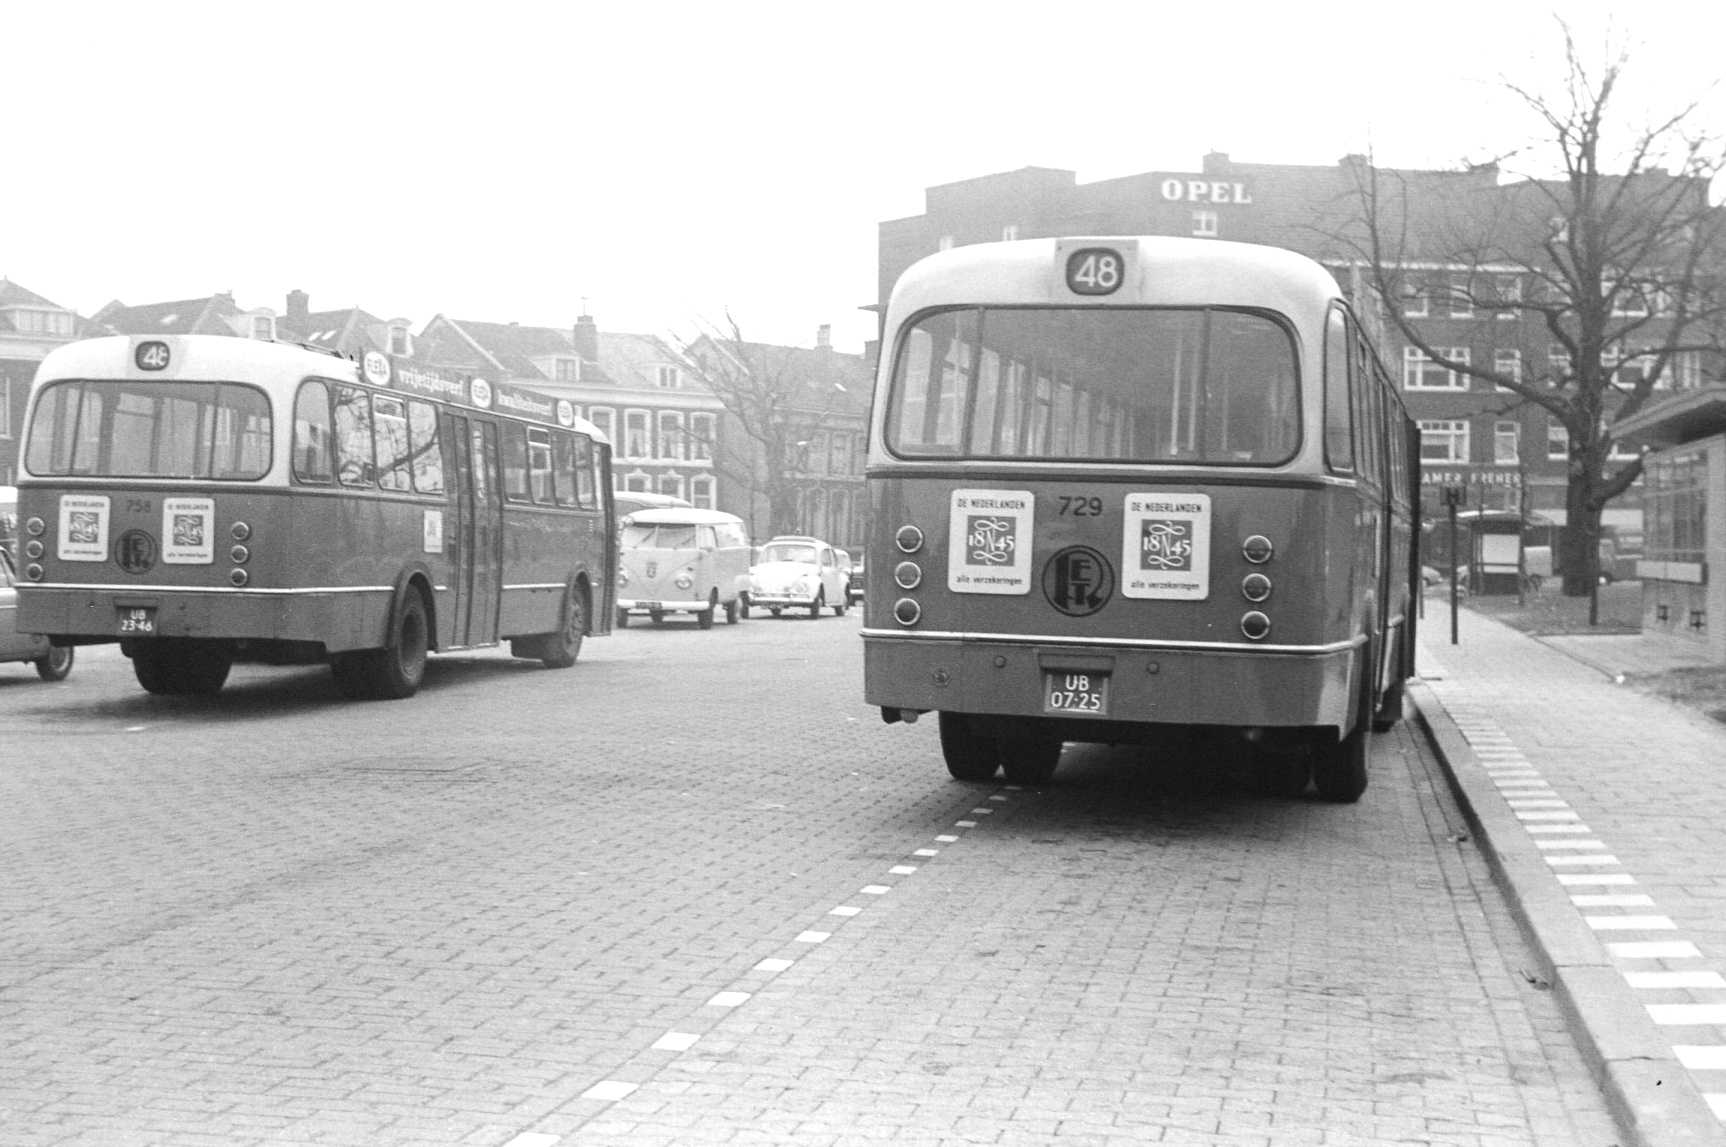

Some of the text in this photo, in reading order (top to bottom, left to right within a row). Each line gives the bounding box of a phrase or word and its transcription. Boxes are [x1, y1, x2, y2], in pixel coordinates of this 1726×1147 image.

[1161, 178, 1252, 204] OPEL
[1075, 255, 1118, 287] 48
[957, 498, 1026, 509] DE NEDERLANDEN
[1058, 496, 1102, 516] 729
[1131, 502, 1202, 512] DE NEDERLANDEN
[1065, 674, 1089, 692] UB
